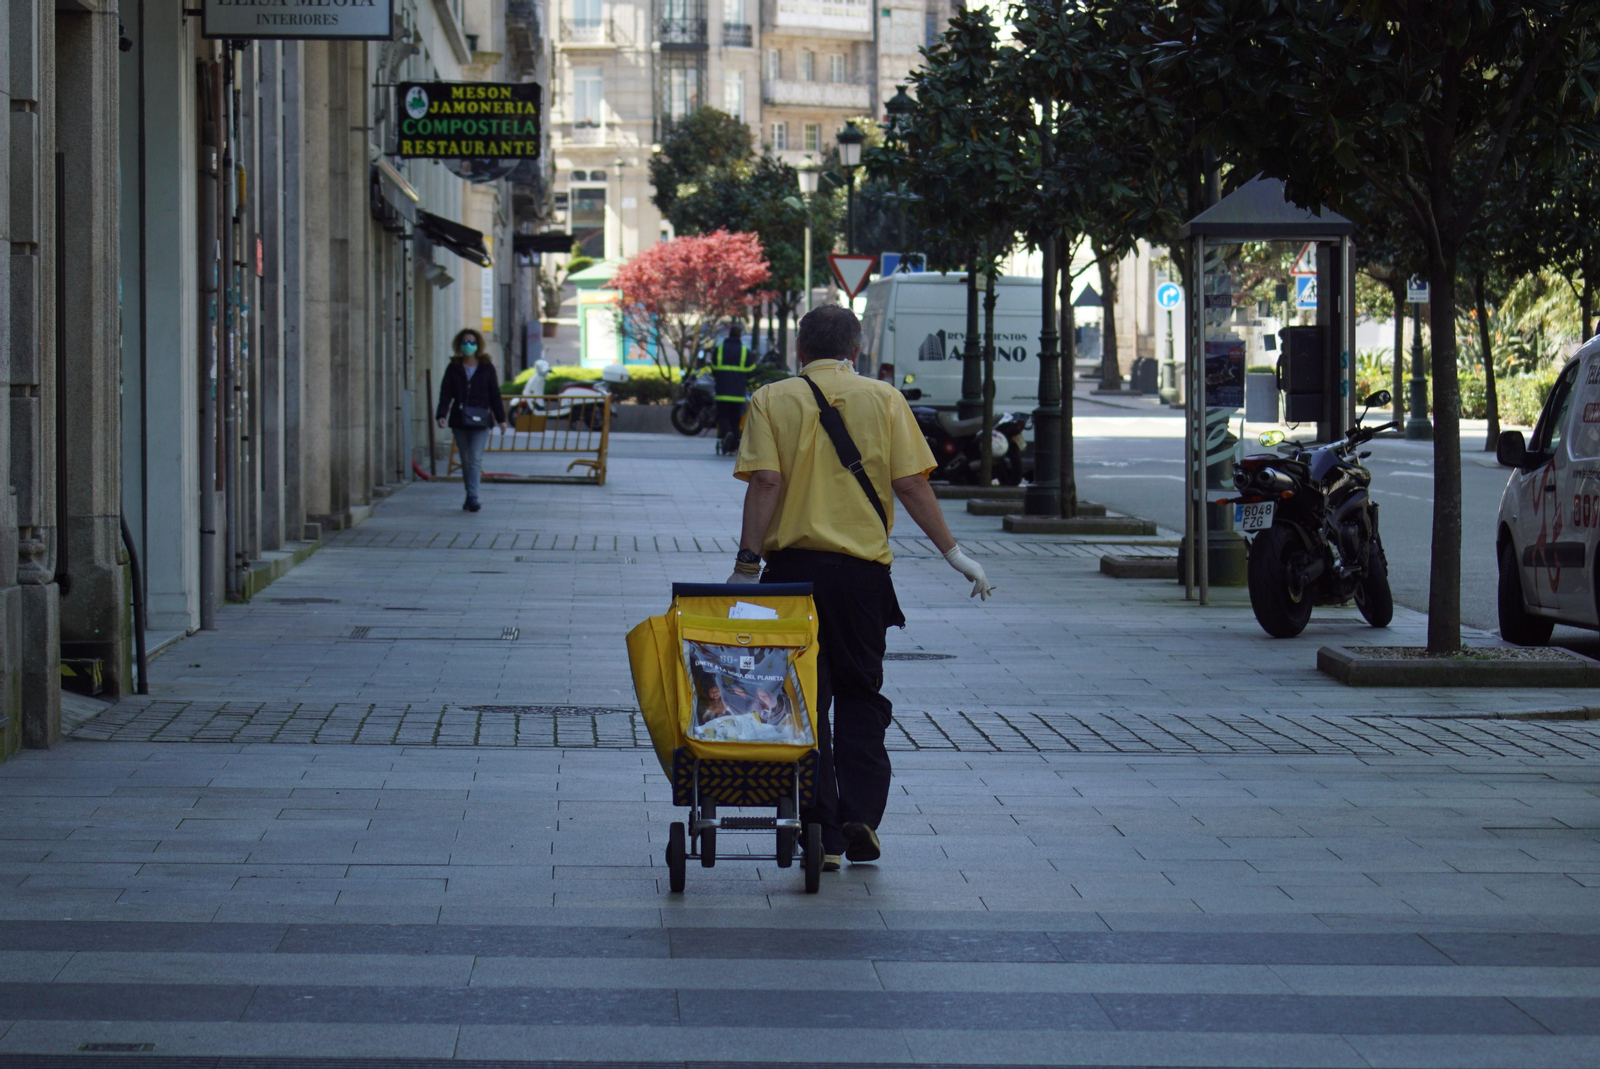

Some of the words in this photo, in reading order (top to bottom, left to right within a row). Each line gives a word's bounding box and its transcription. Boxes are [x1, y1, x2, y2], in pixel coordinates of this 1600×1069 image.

[256, 13, 339, 26] INTERIORES
[451, 86, 512, 99] MESON
[429, 101, 536, 114] JAMONERIA
[402, 119, 536, 136] COMPOSTELA
[401, 140, 536, 155] RESTAURANTE
[1244, 504, 1273, 517] 6048
[1242, 516, 1264, 529] FZG
